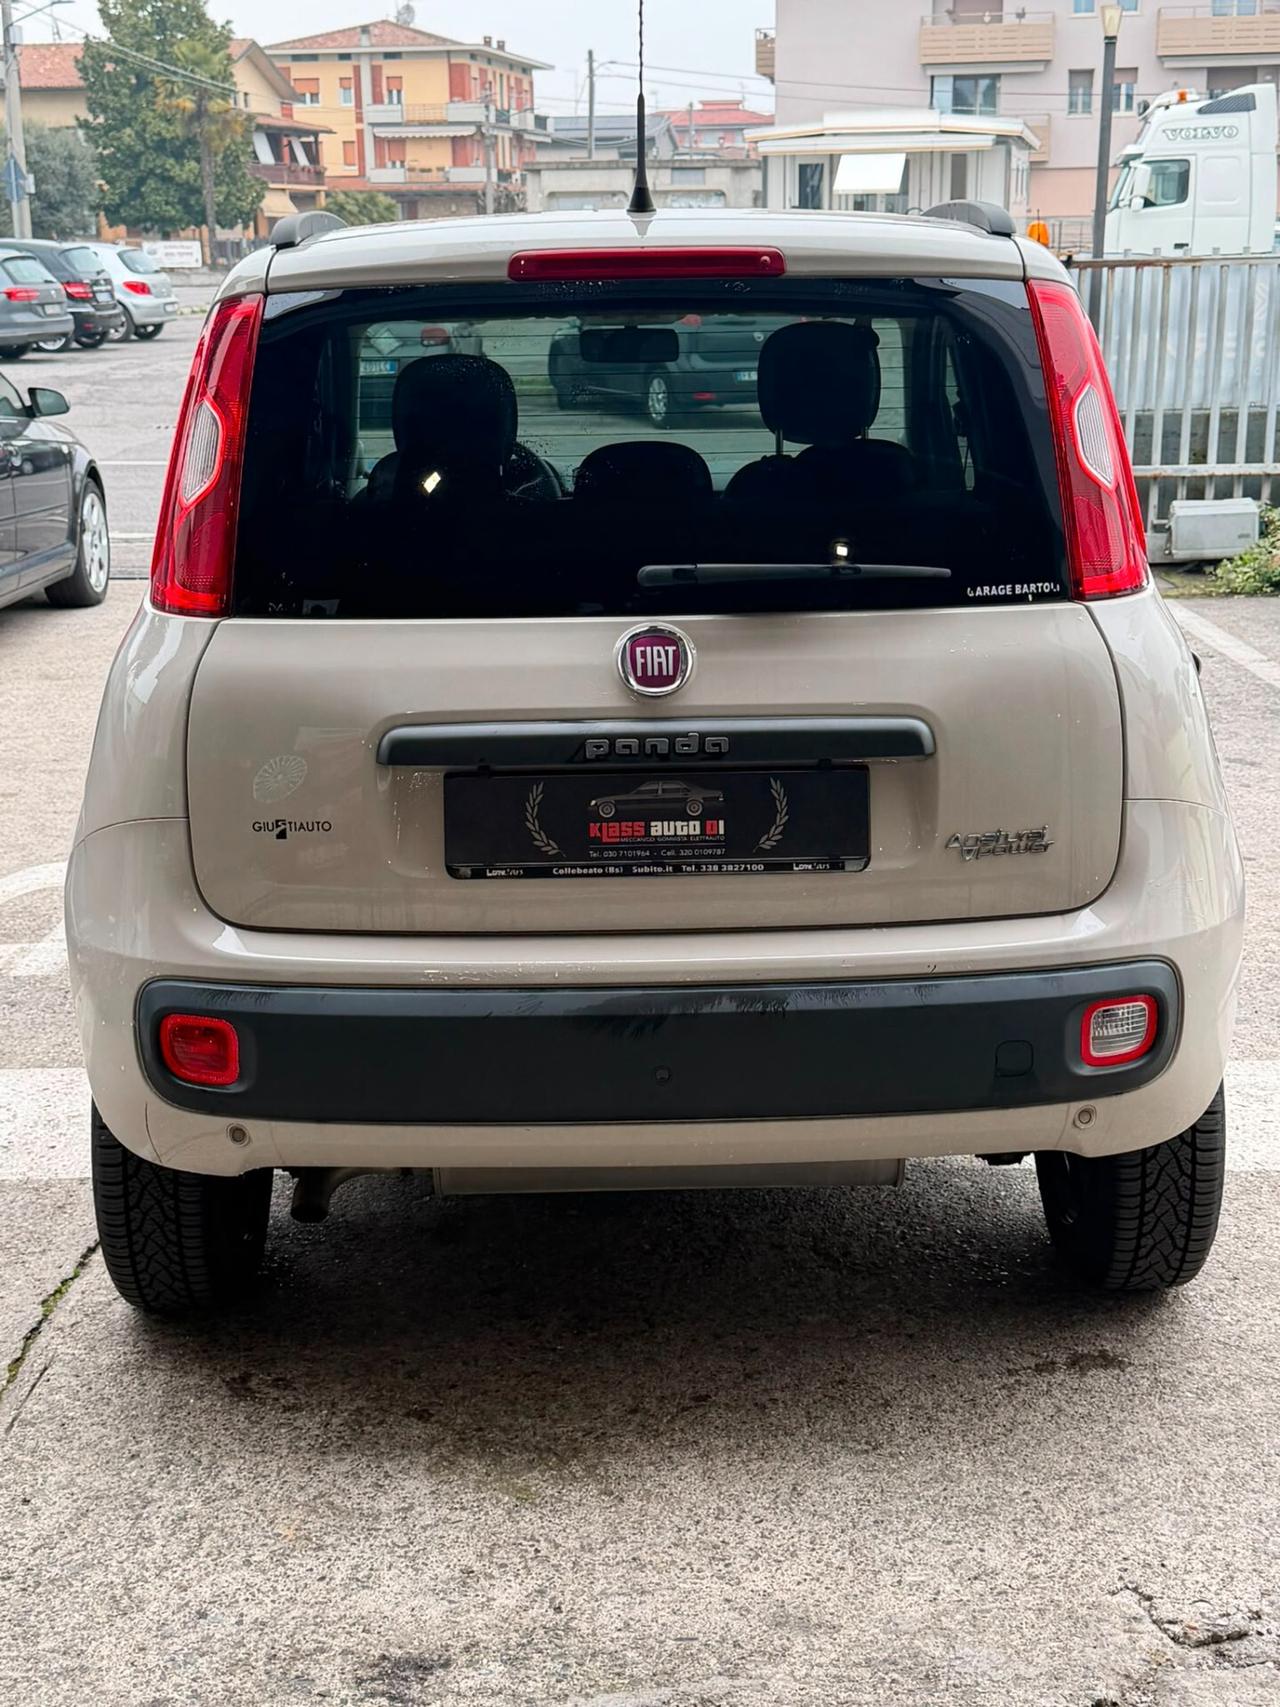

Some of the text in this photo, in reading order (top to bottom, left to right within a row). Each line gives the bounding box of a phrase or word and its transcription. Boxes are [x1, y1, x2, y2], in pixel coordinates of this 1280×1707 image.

[1163, 125, 1239, 141] VOLVO
[635, 646, 676, 677] FIAT
[553, 866, 604, 876] Collebeato
[632, 863, 674, 874] Subito.it
[681, 863, 699, 873] Tel.
[721, 862, 765, 872] 3827100
